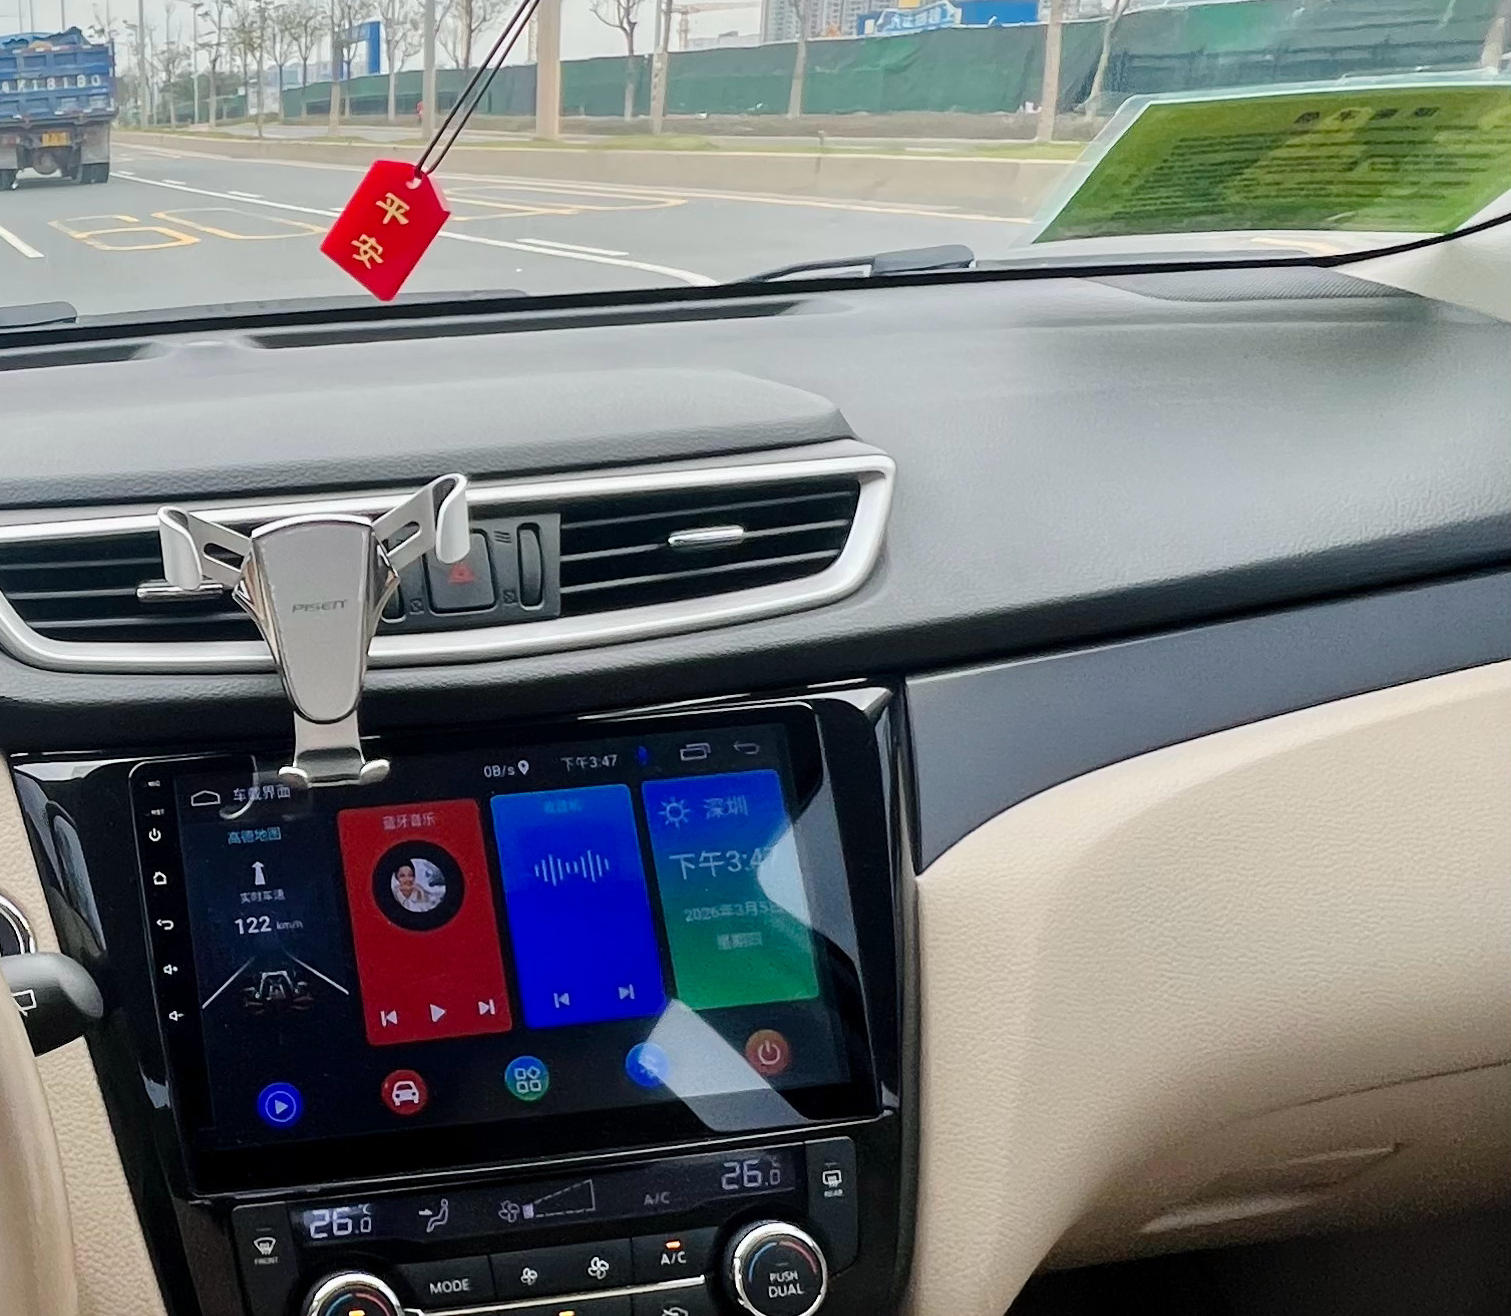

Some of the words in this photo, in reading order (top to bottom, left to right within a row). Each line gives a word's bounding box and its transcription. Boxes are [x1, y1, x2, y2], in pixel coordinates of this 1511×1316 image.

[351, 192, 410, 270] 平安
[561, 754, 618, 771] 下午3:47
[483, 765, 516, 778] 0B/s
[703, 794, 749, 820] 深圳
[227, 826, 282, 845] 高德地图
[234, 915, 272, 935] 122
[721, 1159, 781, 1191] 26.0
[644, 1191, 670, 1206] A/C
[310, 1206, 372, 1239] 26.0
[660, 1250, 687, 1266] A/C
[769, 1270, 798, 1282] PUSH
[429, 1278, 470, 1295] MODE
[768, 1283, 805, 1299] DUAL
